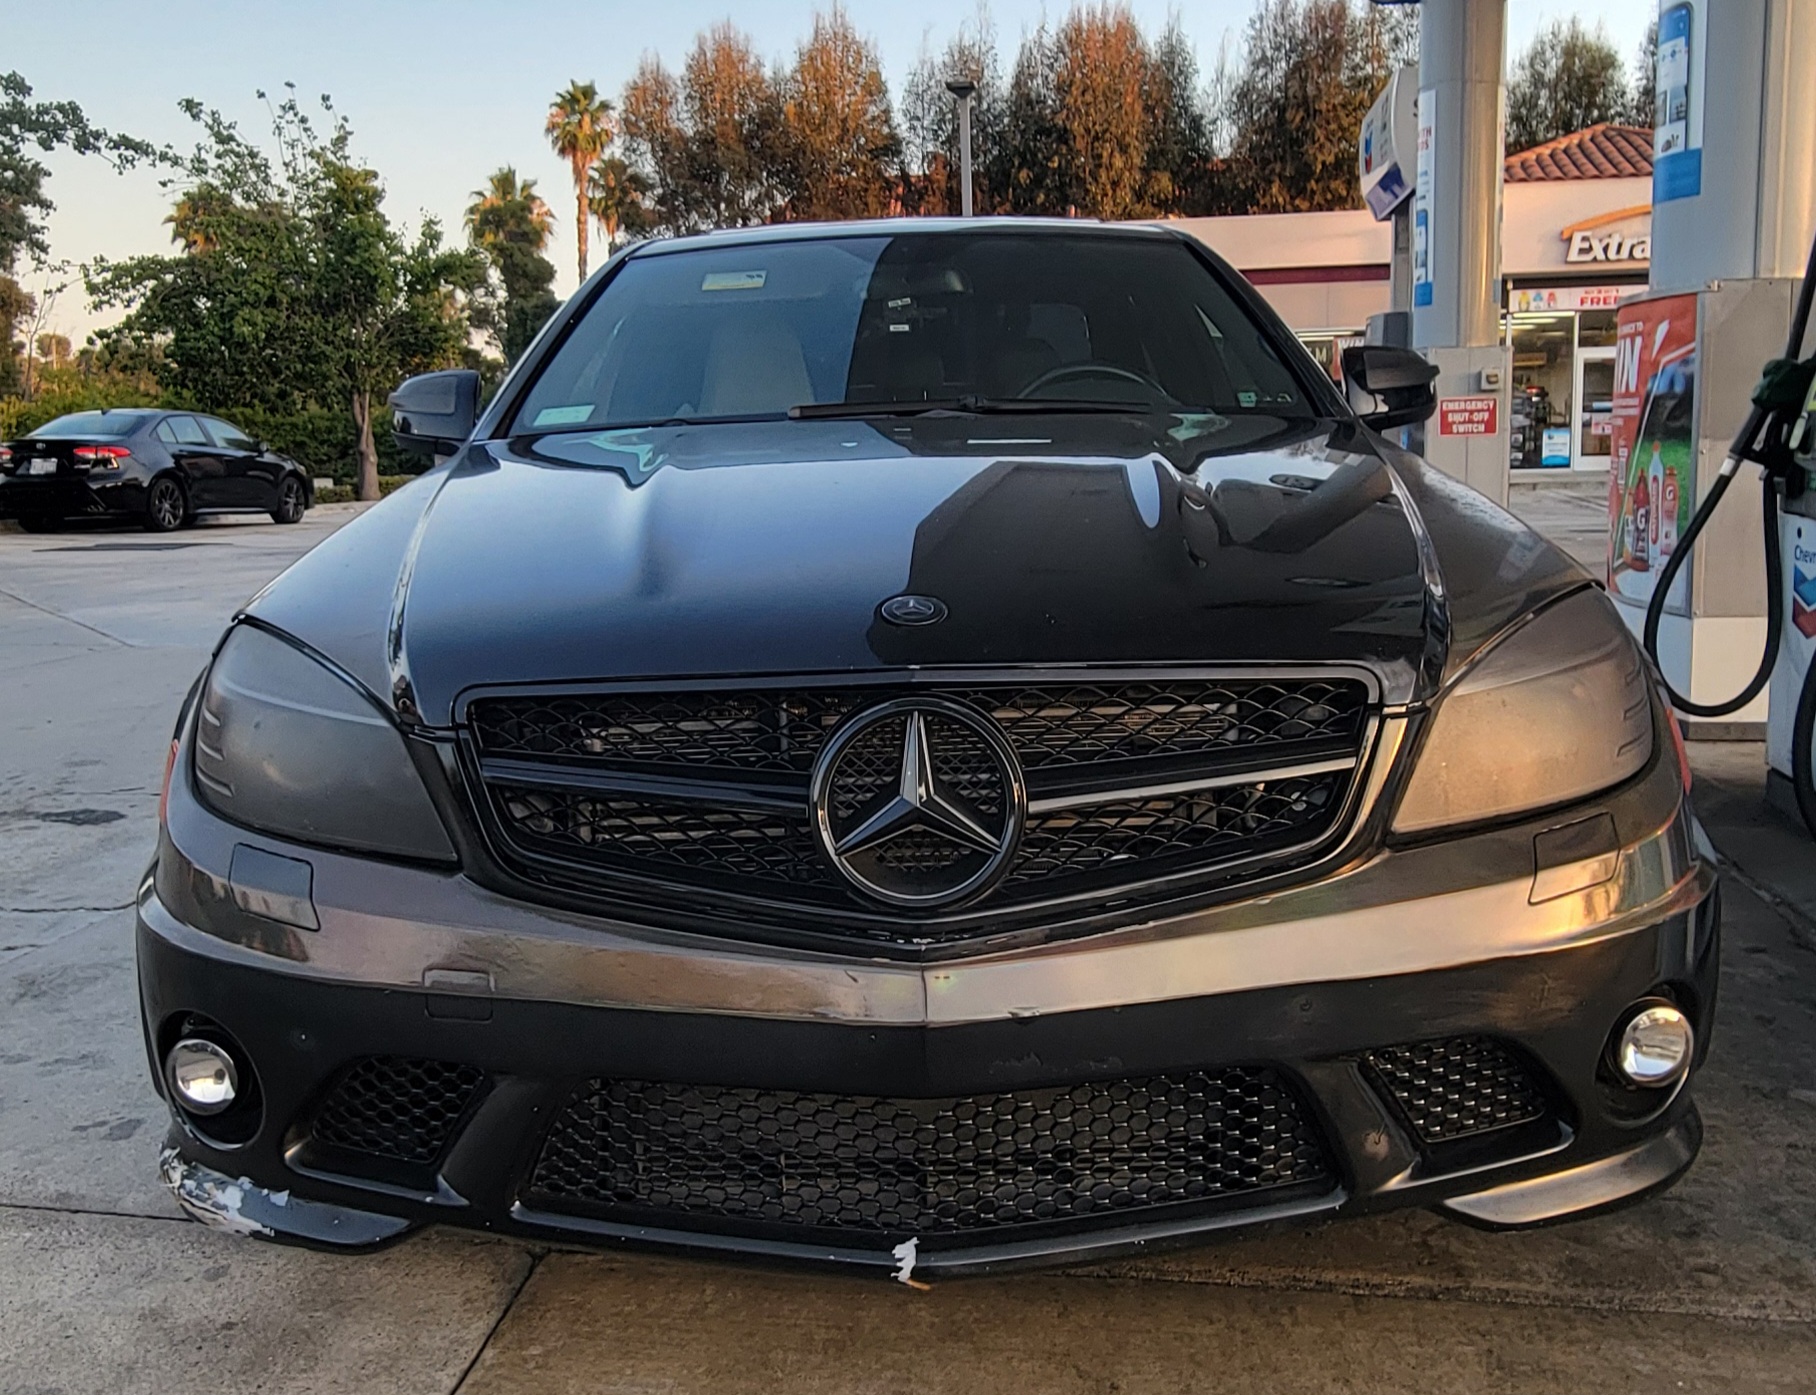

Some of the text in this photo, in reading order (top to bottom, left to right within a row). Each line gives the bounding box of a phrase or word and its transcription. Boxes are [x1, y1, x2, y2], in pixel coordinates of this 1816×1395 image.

[1566, 231, 1651, 262] Extra
[1442, 400, 1495, 411] EMERGENCY
[1447, 411, 1490, 422] SHUT-OFF
[1452, 422, 1485, 433] SWITCH
